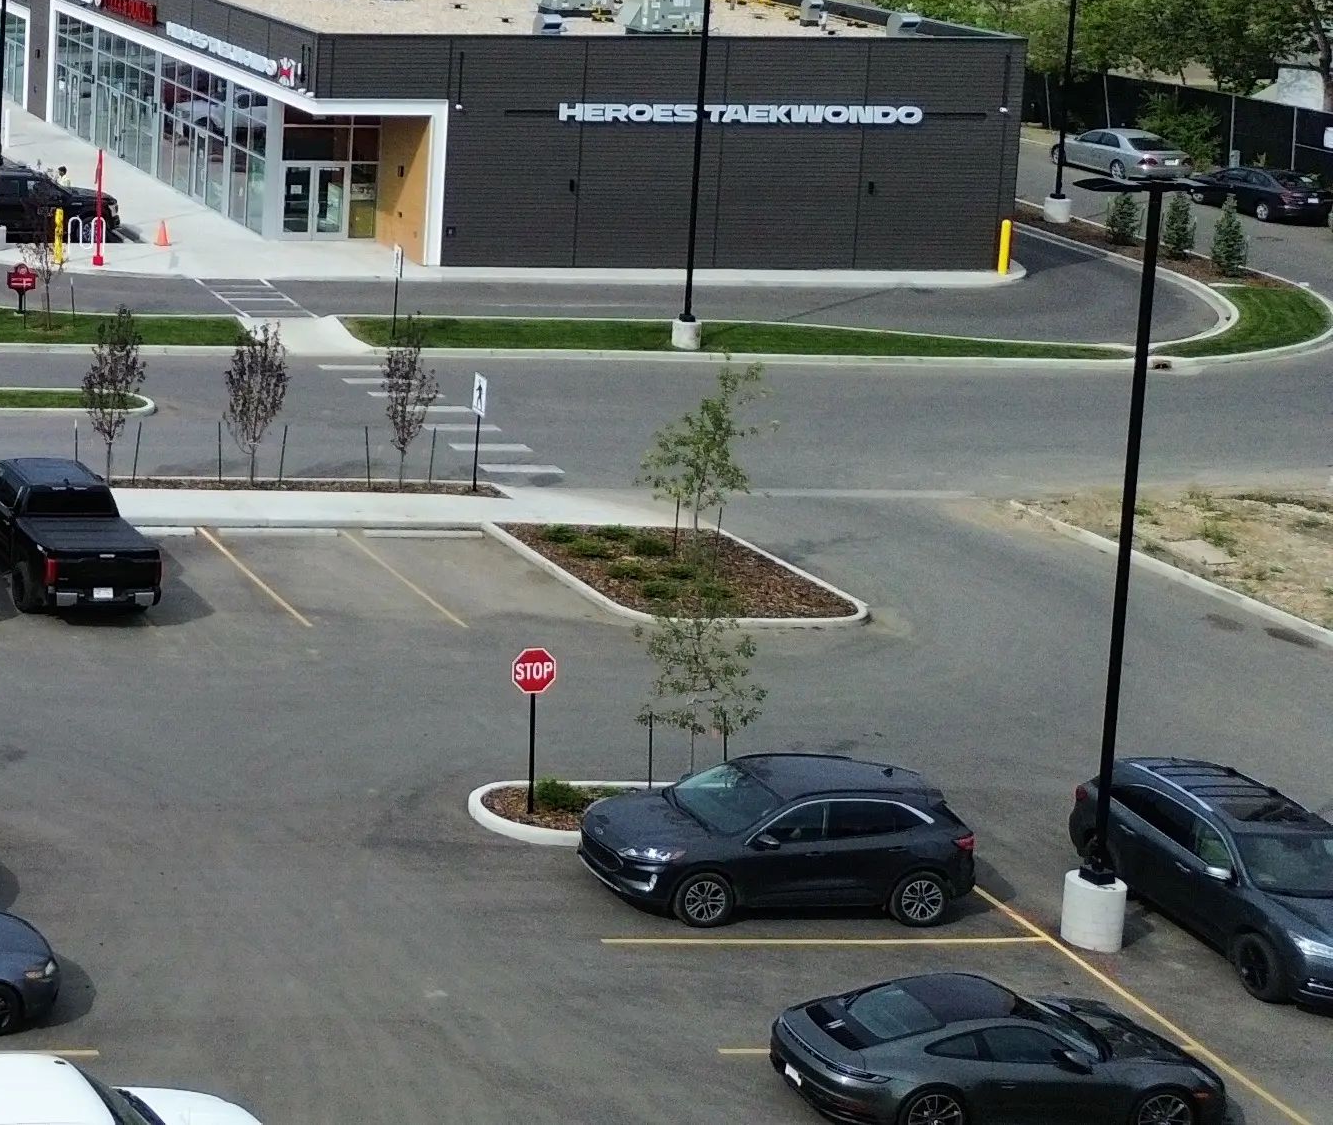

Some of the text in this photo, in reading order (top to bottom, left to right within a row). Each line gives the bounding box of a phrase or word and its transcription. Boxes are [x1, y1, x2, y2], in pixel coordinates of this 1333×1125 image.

[558, 102, 923, 124] HEROES TAEKWONDO
[515, 661, 553, 681] STOP
